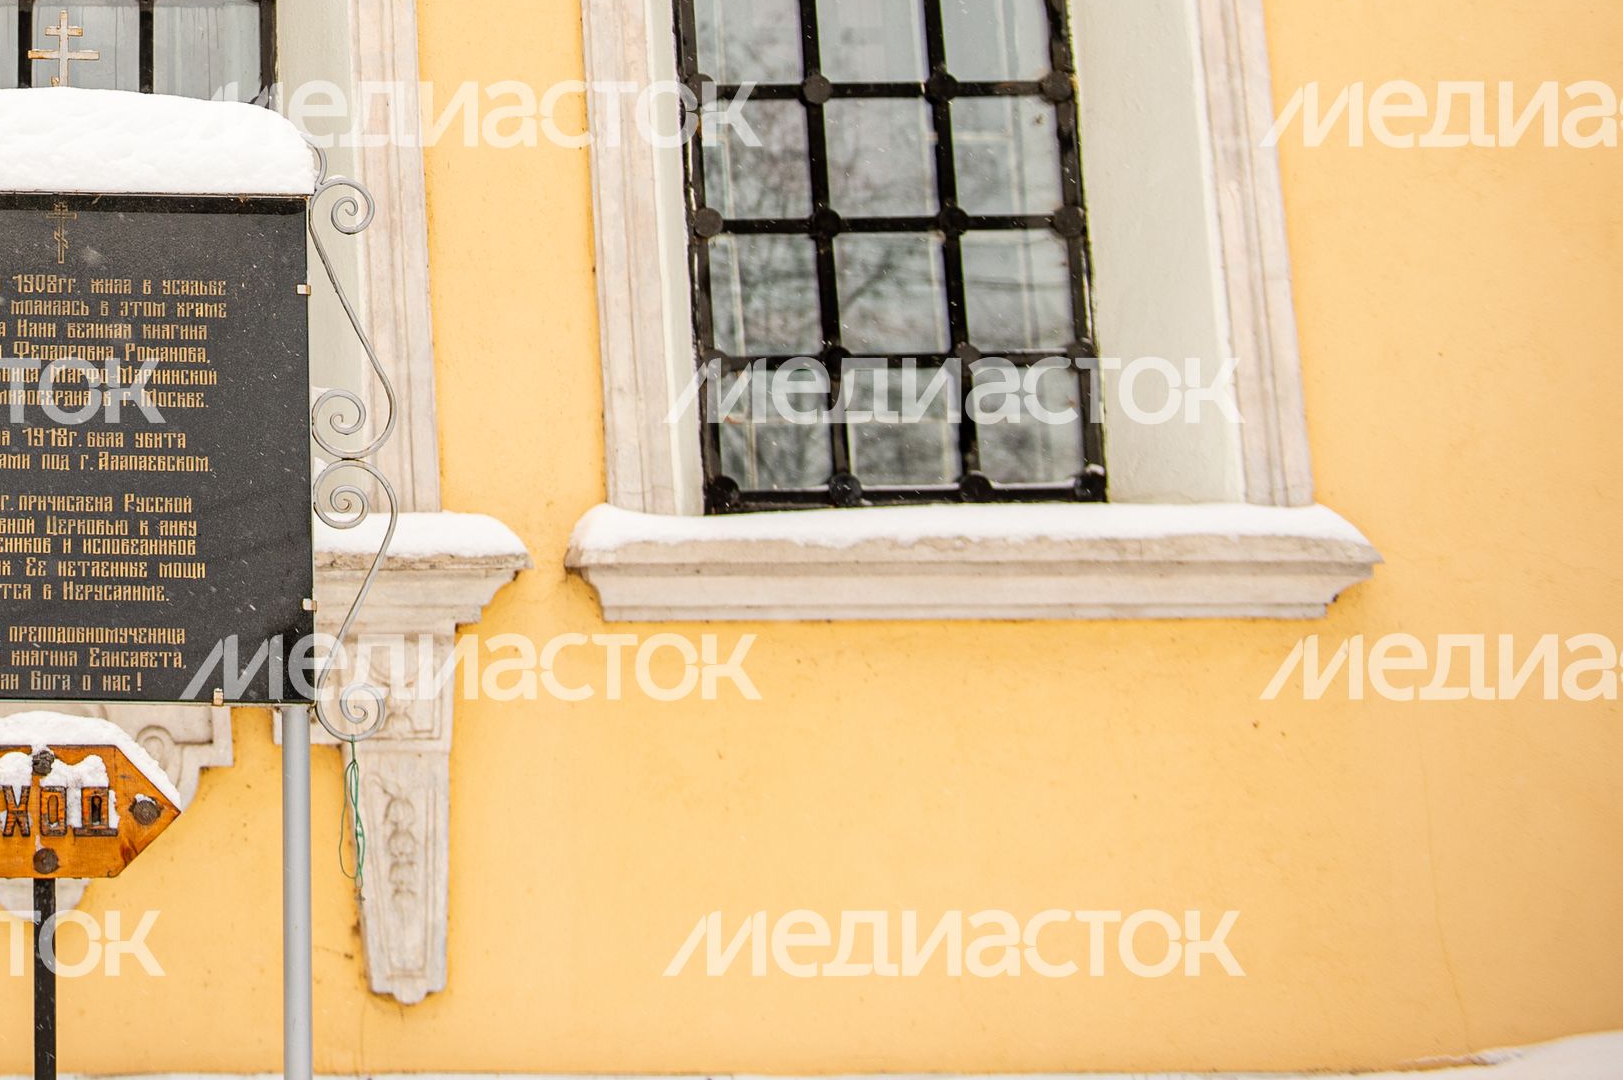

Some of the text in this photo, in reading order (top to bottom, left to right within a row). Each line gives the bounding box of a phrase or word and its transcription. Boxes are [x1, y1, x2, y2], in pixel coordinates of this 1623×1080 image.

[90, 278, 132, 294] жила
[143, 278, 152, 295] в
[162, 279, 227, 297] усадьбе
[10, 300, 90, 317] молилась
[100, 300, 109, 317] в
[119, 301, 166, 317] этом
[176, 301, 227, 319] храме
[17, 320, 57, 339] Илии
[66, 322, 132, 339] великая
[142, 323, 207, 340] княгиня
[13, 340, 115, 362] Феодоровна
[124, 343, 211, 365] Романова,
[102, 390, 111, 407] в
[22, 427, 82, 448] 1918г.
[87, 431, 124, 448] была
[134, 431, 187, 449] убита
[41, 454, 70, 471] под
[18, 495, 113, 513] причислена
[124, 493, 193, 514] Русской
[46, 515, 128, 535] Церковью
[139, 519, 149, 535] к
[159, 520, 197, 537] лику
[63, 538, 72, 554] и
[83, 538, 197, 556] исповедников
[26, 557, 47, 577] Ее
[57, 560, 148, 578] нетленные
[159, 561, 206, 579] мощи
[43, 584, 52, 600] в
[63, 581, 170, 602] Иерусалиме.
[9, 625, 186, 645] преподобномученица
[11, 650, 78, 667] княгиня
[89, 647, 187, 669] Елисавета,
[30, 671, 71, 691] Бога
[82, 675, 91, 692] о
